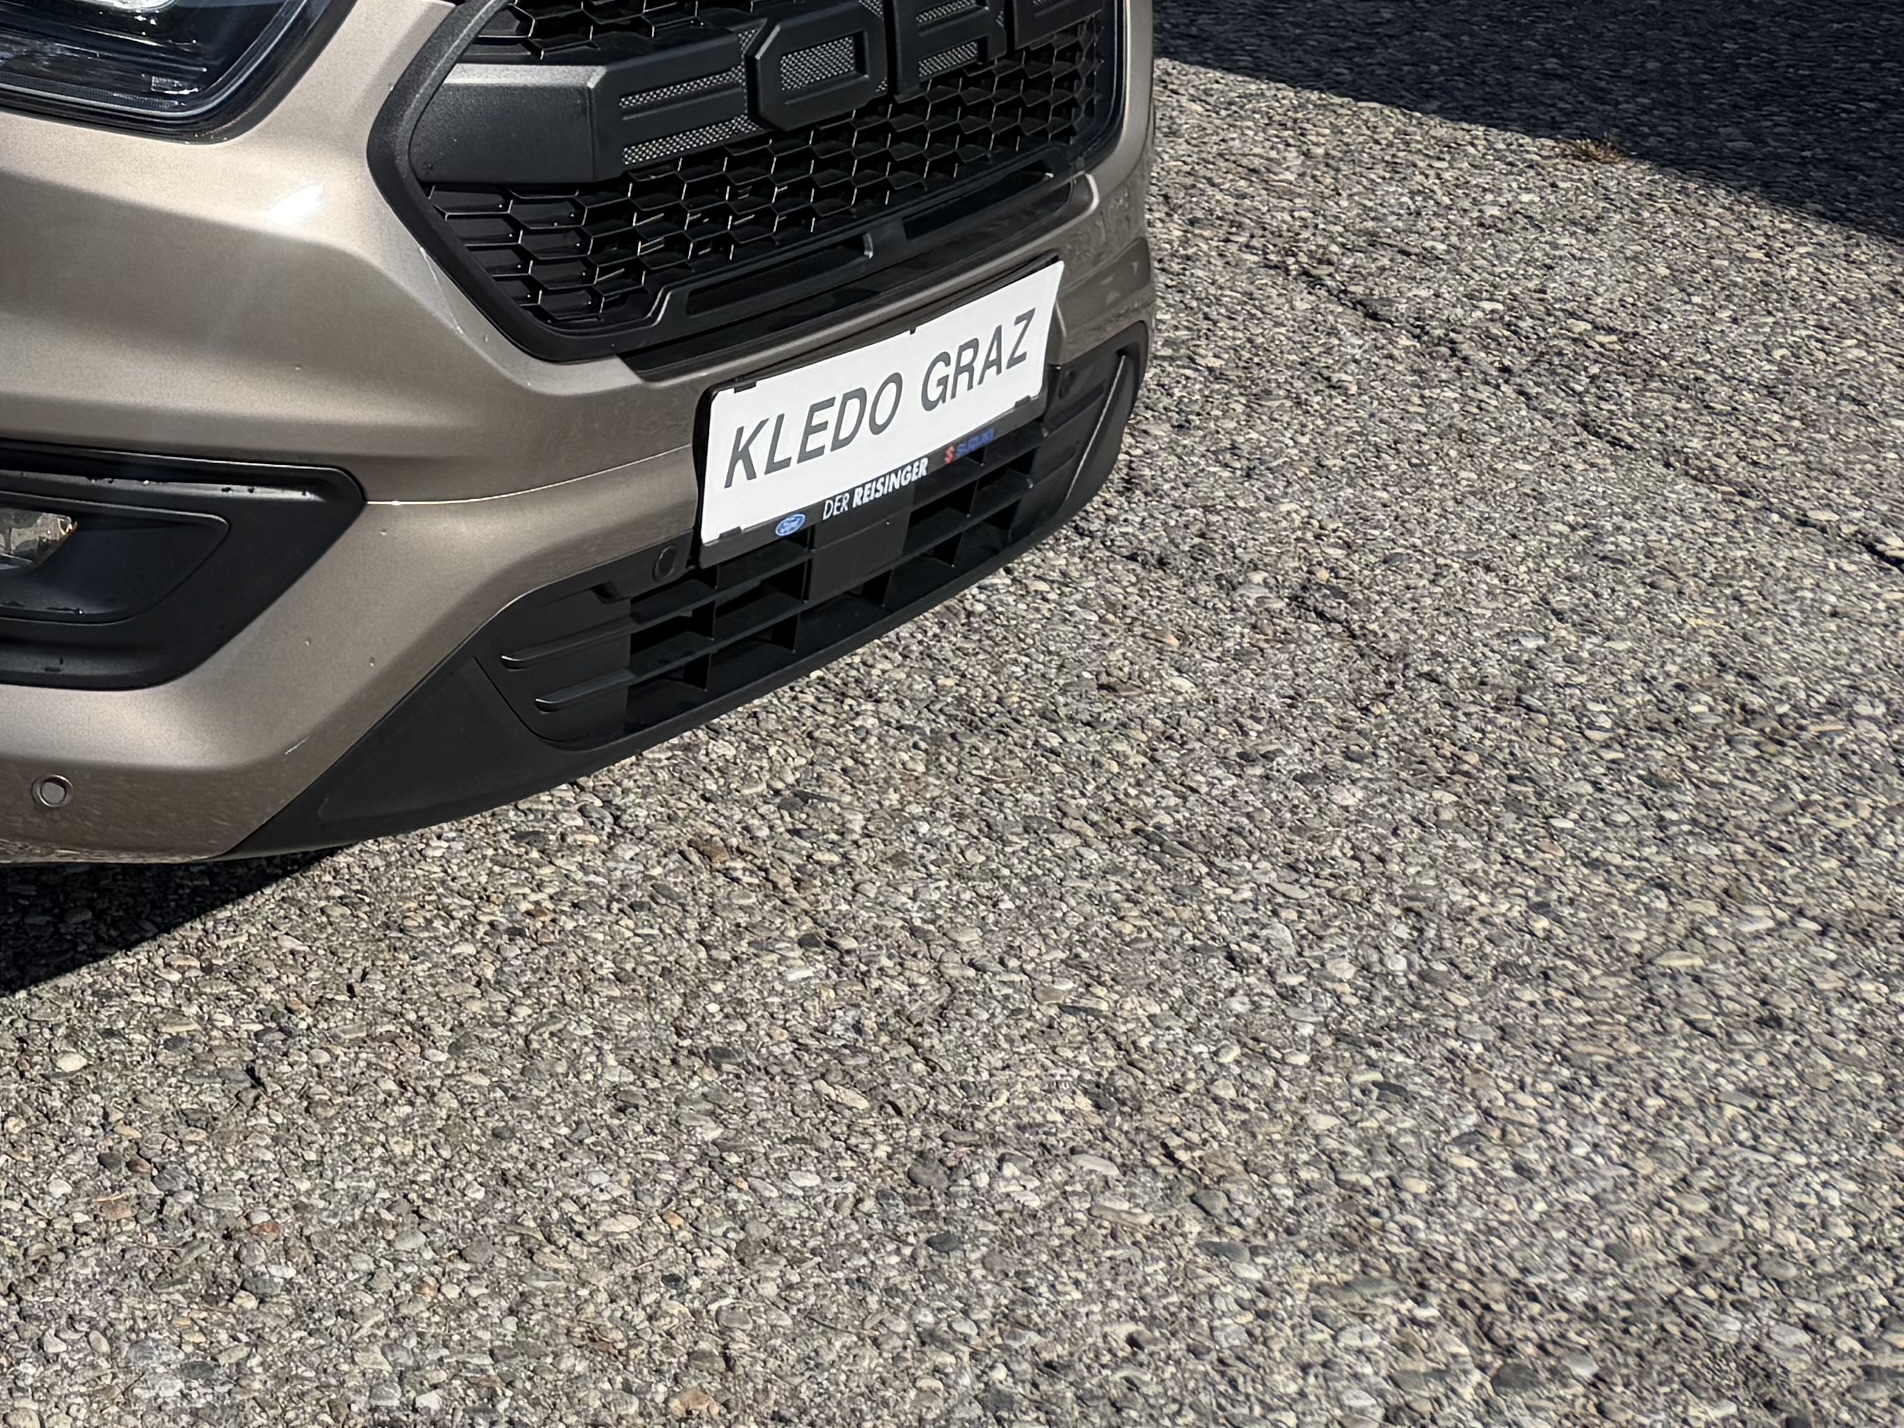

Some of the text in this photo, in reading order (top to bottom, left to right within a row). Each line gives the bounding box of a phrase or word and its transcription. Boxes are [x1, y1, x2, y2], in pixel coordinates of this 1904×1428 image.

[724, 308, 1036, 489] KLEDO GRAZ
[822, 493, 851, 521] DER
[852, 457, 930, 509] REISINGER
